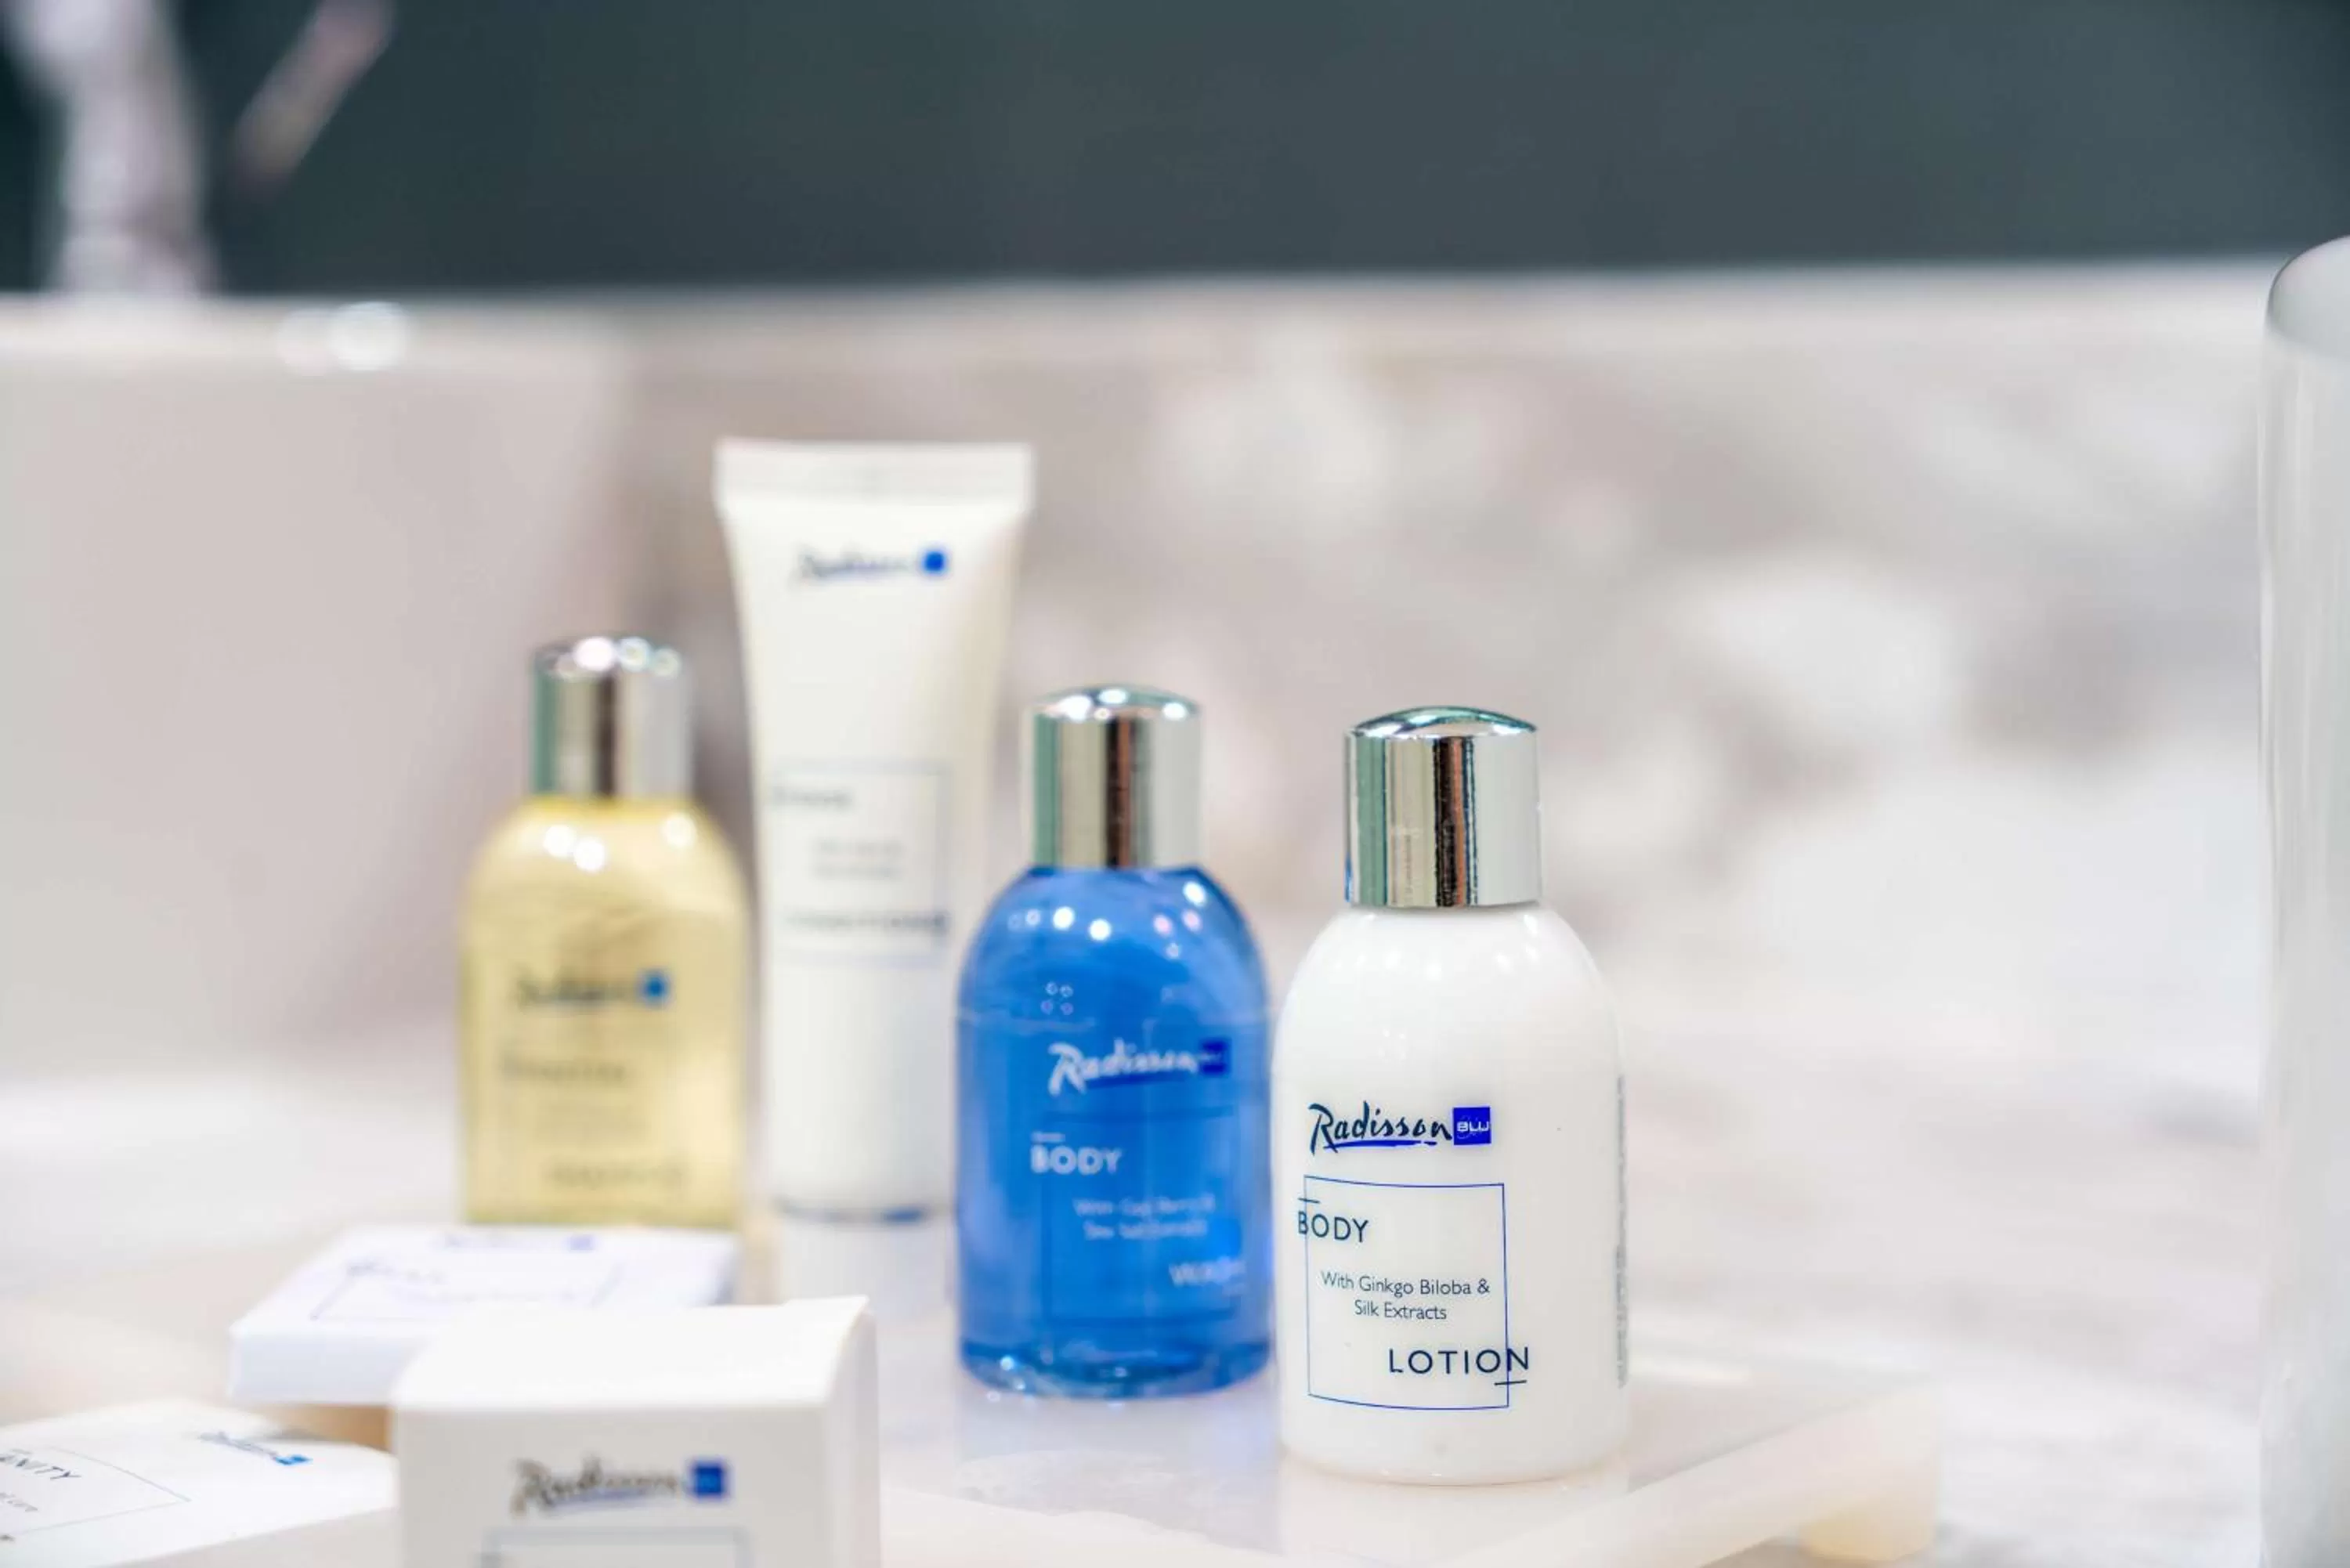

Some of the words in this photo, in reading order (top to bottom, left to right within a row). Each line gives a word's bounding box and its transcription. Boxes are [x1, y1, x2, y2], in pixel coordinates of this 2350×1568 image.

[1307, 1100, 1452, 1155] Radisson
[1457, 1121, 1489, 1132] BLU
[1029, 1145, 1122, 1174] BODY
[1297, 1211, 1368, 1242] BODY
[1321, 1271, 1354, 1290] With
[1359, 1275, 1413, 1298] Ginkgo
[1420, 1279, 1471, 1296] Biloba
[1477, 1279, 1490, 1294] &
[1354, 1299, 1379, 1317] Silk
[1384, 1302, 1447, 1321] Extracts
[1389, 1347, 1528, 1375] LOTION
